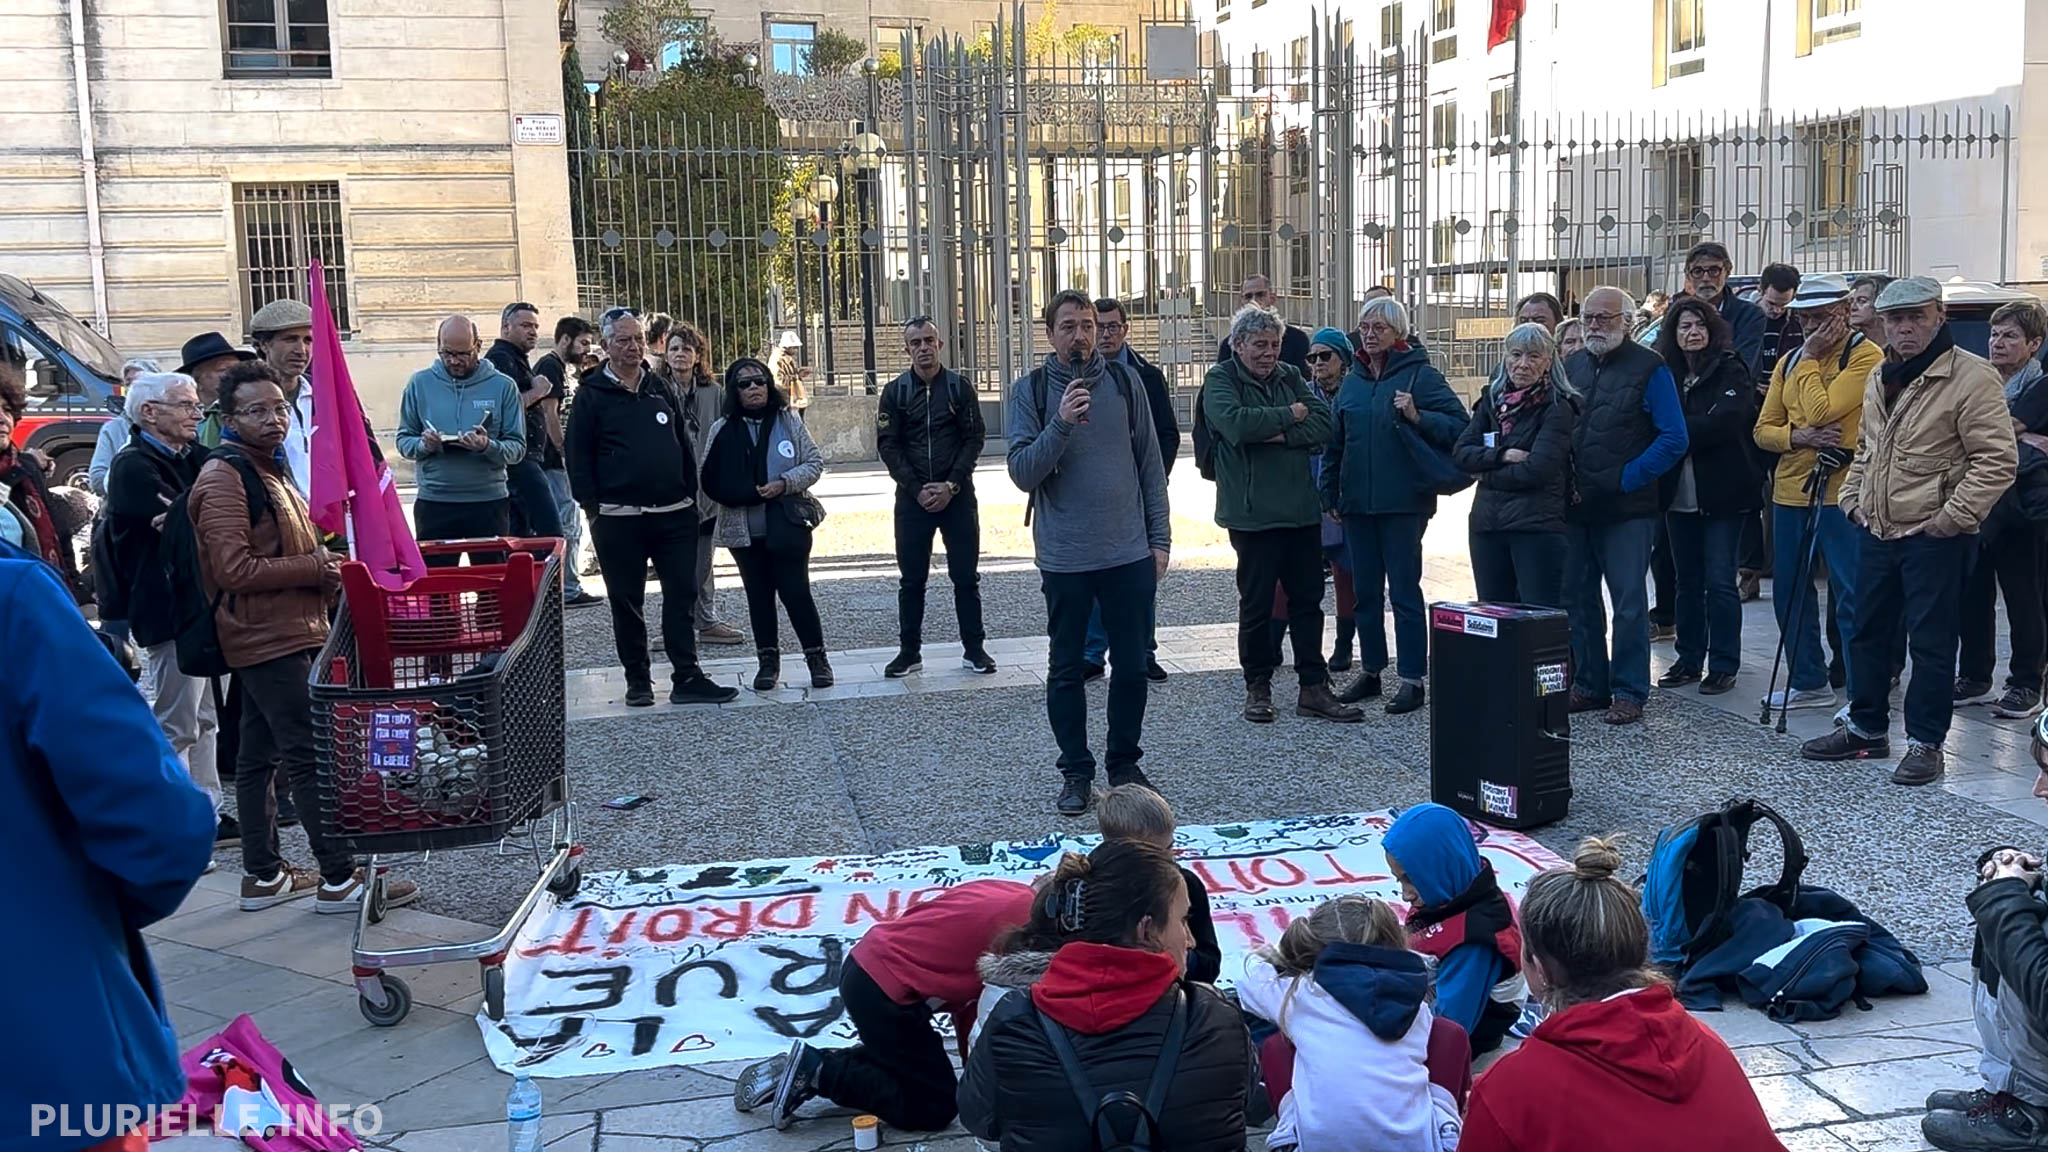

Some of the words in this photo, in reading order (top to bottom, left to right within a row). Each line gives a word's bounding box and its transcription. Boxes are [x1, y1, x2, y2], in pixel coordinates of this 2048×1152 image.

[383, 754, 410, 767] GUEULE
[1252, 890, 1383, 908] LEMENT
[515, 897, 819, 957] DROIT
[521, 937, 843, 1017] RUE
